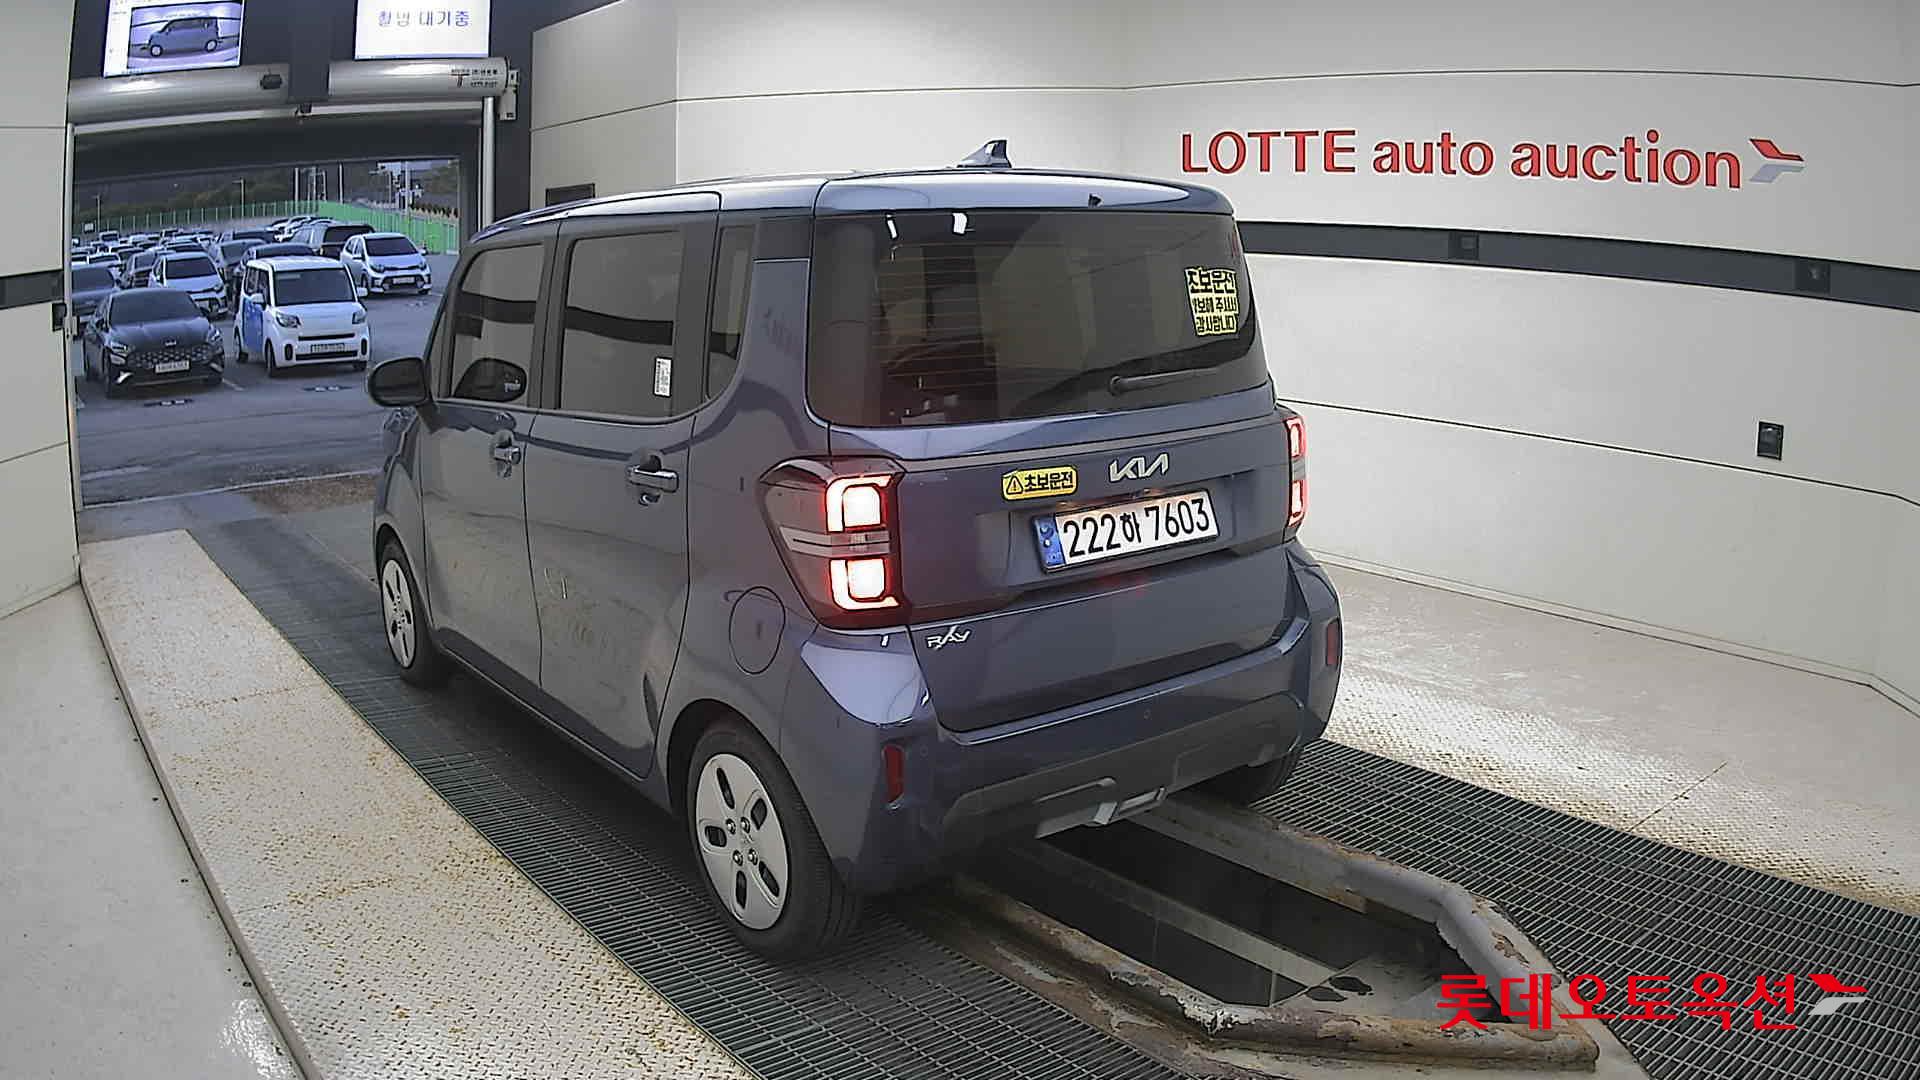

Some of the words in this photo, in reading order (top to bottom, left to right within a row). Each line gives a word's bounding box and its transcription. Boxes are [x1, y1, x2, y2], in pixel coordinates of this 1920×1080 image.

[419, 9, 470, 28] 대기중
[1180, 129, 1358, 175] LOTTE
[1372, 131, 1496, 177] auto
[1509, 128, 1743, 189] auction
[1023, 470, 1075, 492] 초보운전
[1109, 452, 1170, 482] KIA
[1063, 509, 1143, 558] 222하
[1145, 496, 1211, 542] 7603
